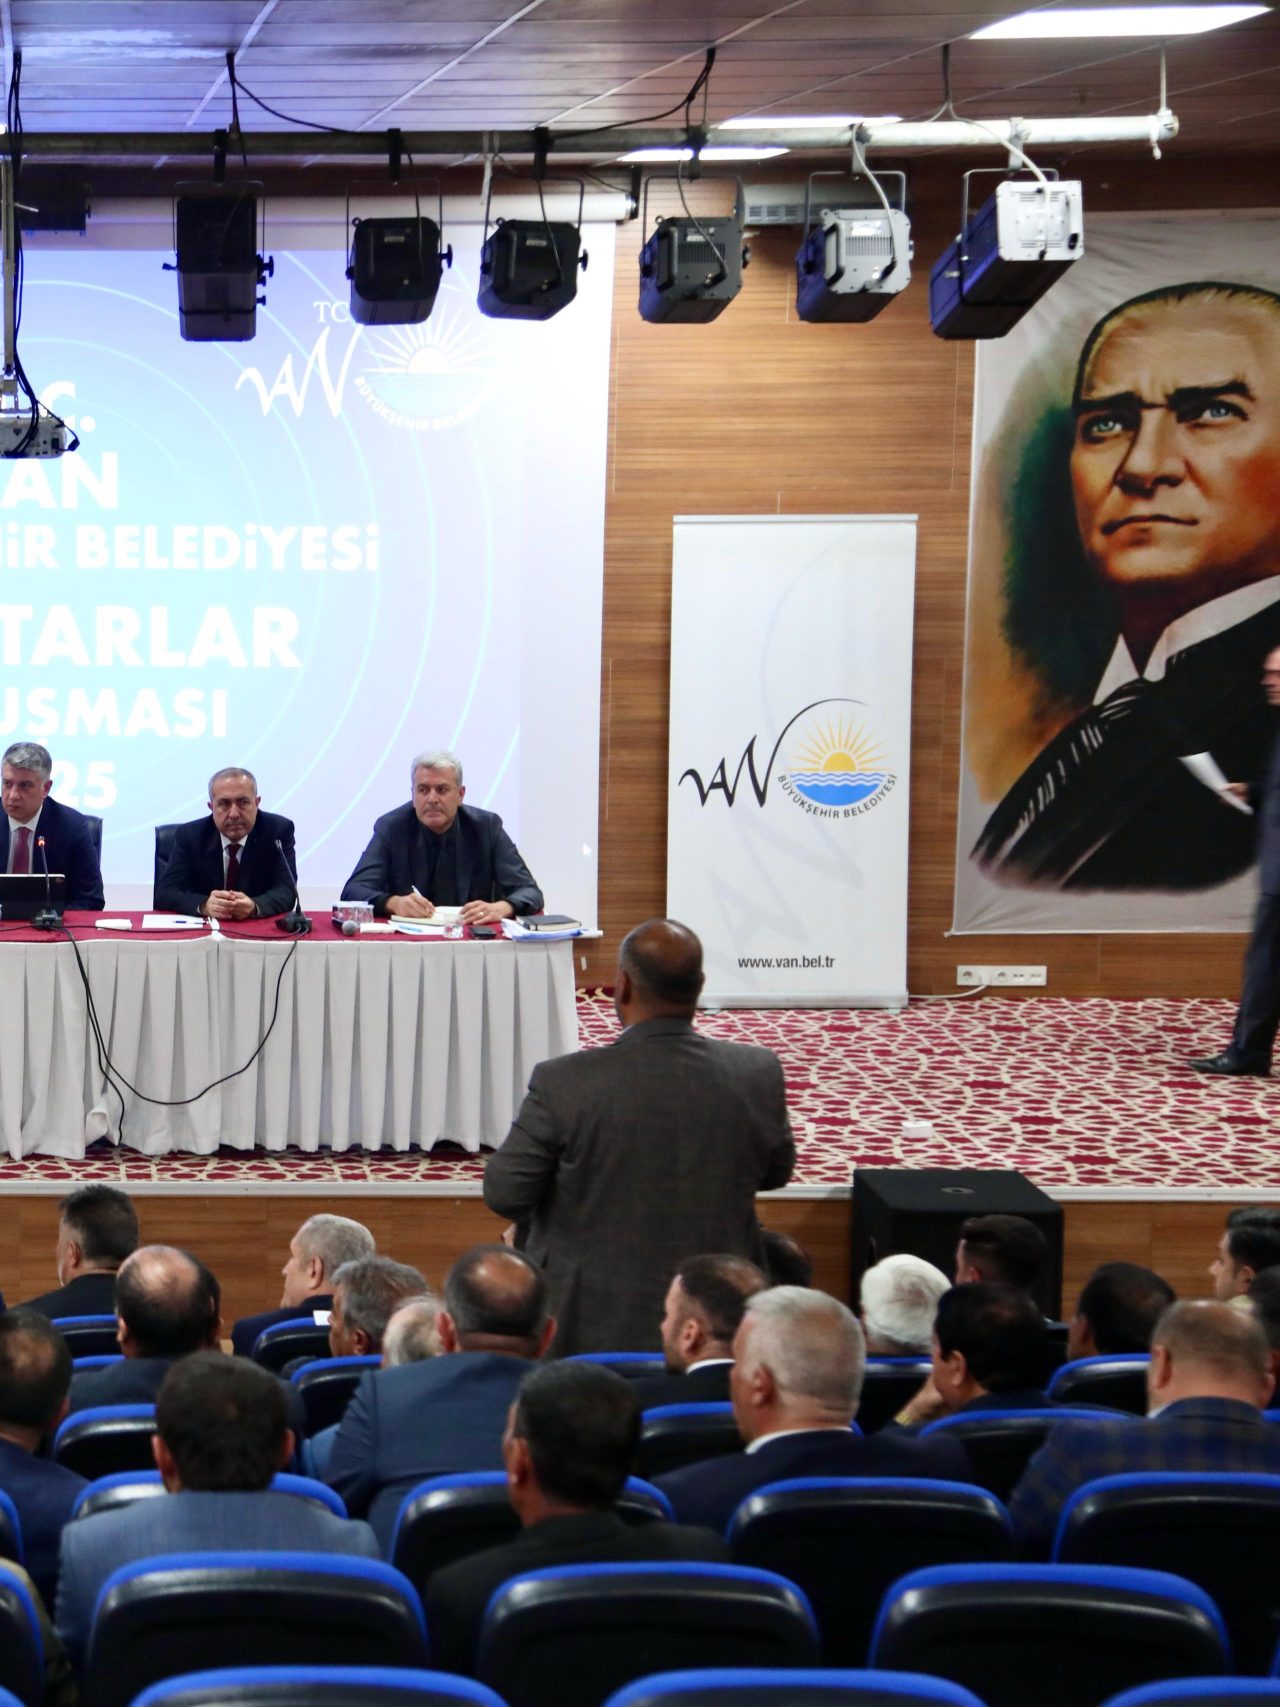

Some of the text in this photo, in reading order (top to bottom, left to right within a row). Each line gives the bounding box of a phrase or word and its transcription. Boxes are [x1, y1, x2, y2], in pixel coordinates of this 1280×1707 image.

[235, 323, 364, 418] VAN
[678, 698, 869, 809] VAN
[778, 774, 898, 819] BÜYÜKŞEHİR BELEDİYESİ
[737, 954, 835, 968] www.van.bel.tr
